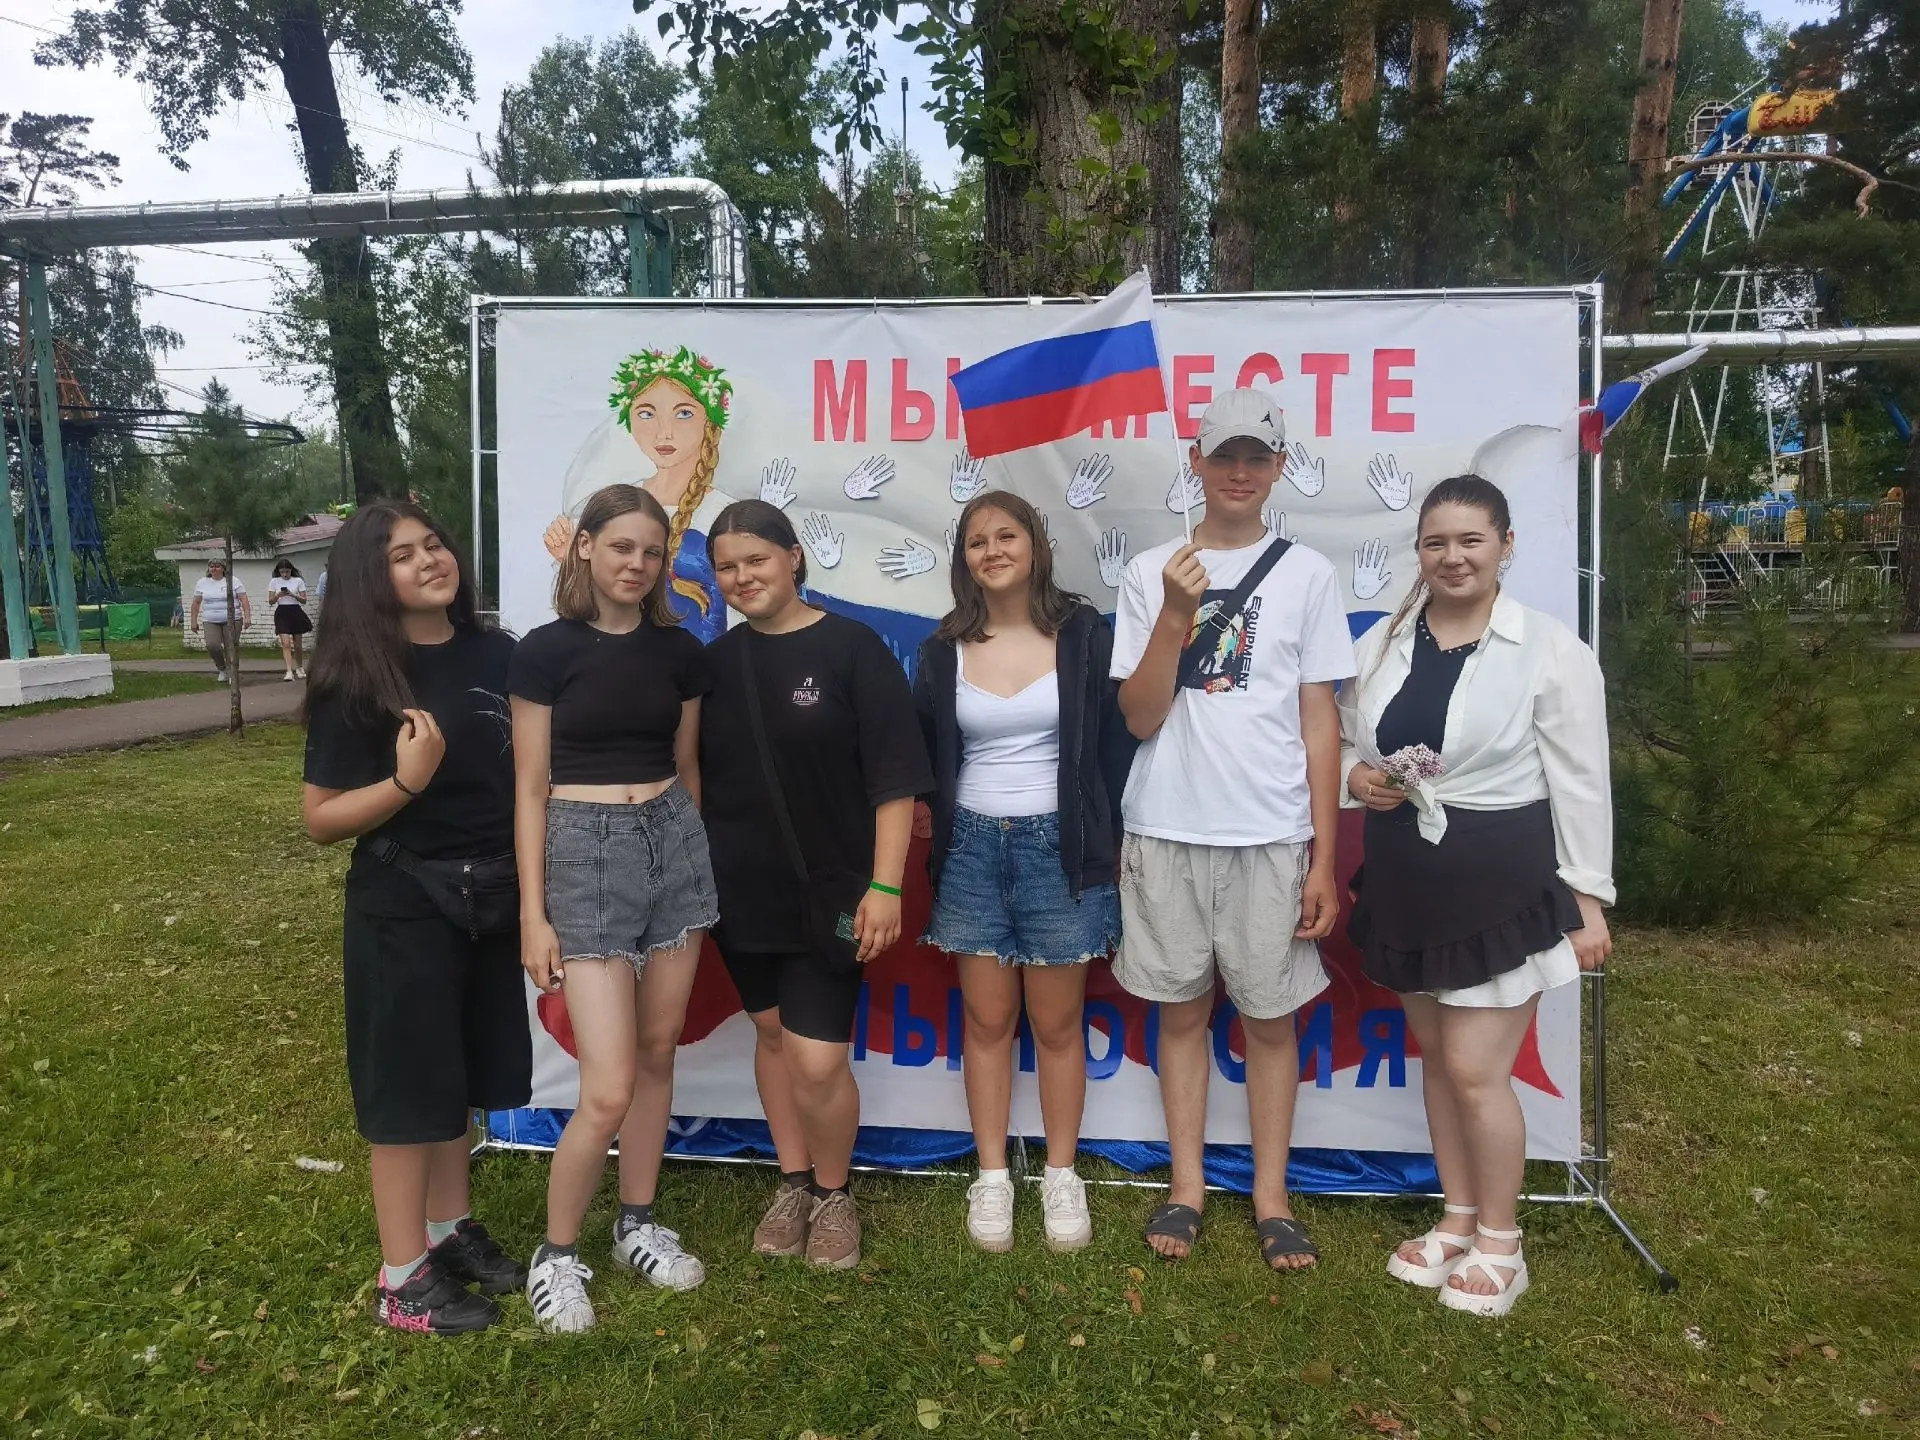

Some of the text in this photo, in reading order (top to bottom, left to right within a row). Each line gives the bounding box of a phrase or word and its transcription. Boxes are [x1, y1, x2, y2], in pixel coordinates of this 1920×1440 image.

[813, 357, 961, 442] МЫ
[1235, 595, 1263, 692] EQUIPMENT
[853, 981, 963, 1072] Ы
